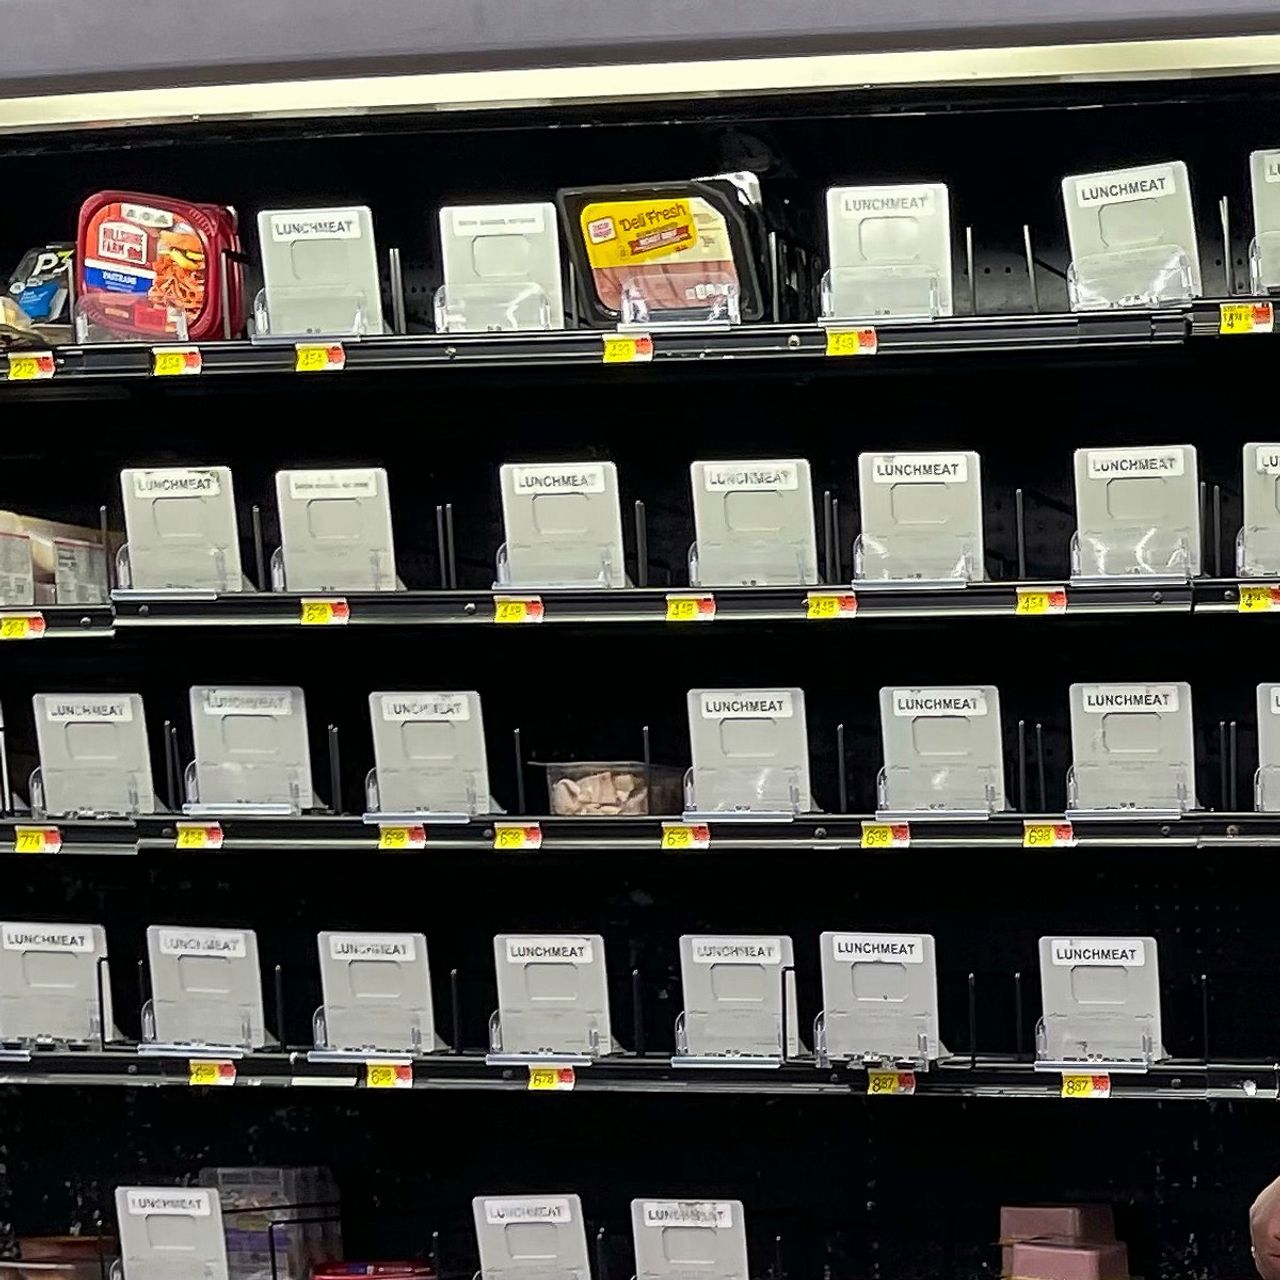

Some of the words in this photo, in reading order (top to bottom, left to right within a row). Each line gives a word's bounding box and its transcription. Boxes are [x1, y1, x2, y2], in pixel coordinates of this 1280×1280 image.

[1082, 178, 1166, 201] LUNCHMEAT
[621, 213, 647, 231] Deli
[648, 204, 687, 223] Fresh
[877, 463, 959, 476] LUNCHMEAT
[1093, 458, 1176, 470] LUNCHMEAT
[898, 698, 977, 709] LUNCHMEAT
[1088, 694, 1169, 705] LUNCHMEAT
[706, 700, 783, 712] LUNCHMEAT
[510, 946, 584, 957] LUNCHMEAT
[838, 943, 915, 954] LUNCHMEAT
[1057, 949, 1135, 960] LUNCHMEAT
